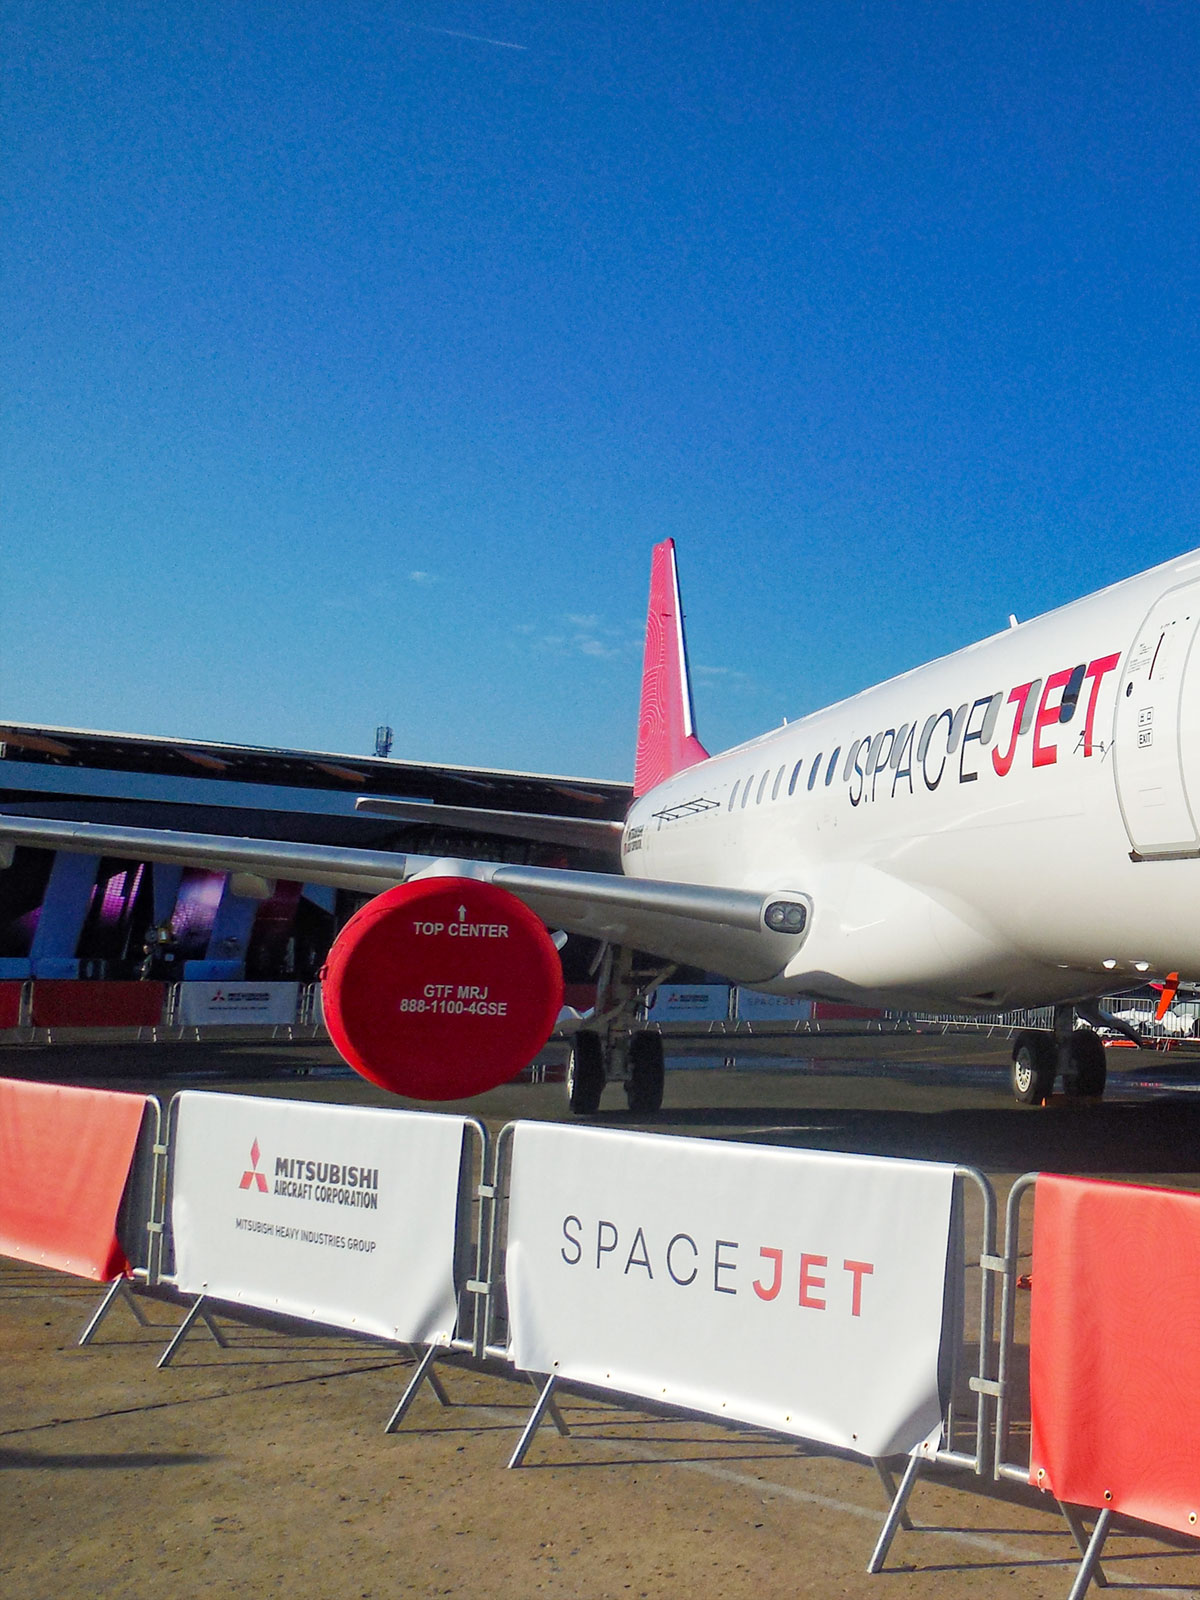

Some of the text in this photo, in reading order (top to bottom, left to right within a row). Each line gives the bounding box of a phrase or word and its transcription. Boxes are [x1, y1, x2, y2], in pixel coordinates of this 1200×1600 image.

[849, 651, 1122, 808] SPACEJET
[1138, 731, 1152, 745] EXIT
[413, 921, 509, 939] TOP CENTER
[400, 998, 508, 1016] 888-1100-4GSE
[423, 984, 489, 1000] GTF MRJ
[274, 1156, 379, 1190] MITSUBISHI
[273, 1179, 378, 1210] AIRCRAFT CORPORATION
[235, 1217, 377, 1254] MITSUBISHI HEAVY INDUSTRIES GROUP
[560, 1214, 875, 1318] SPACEJET
